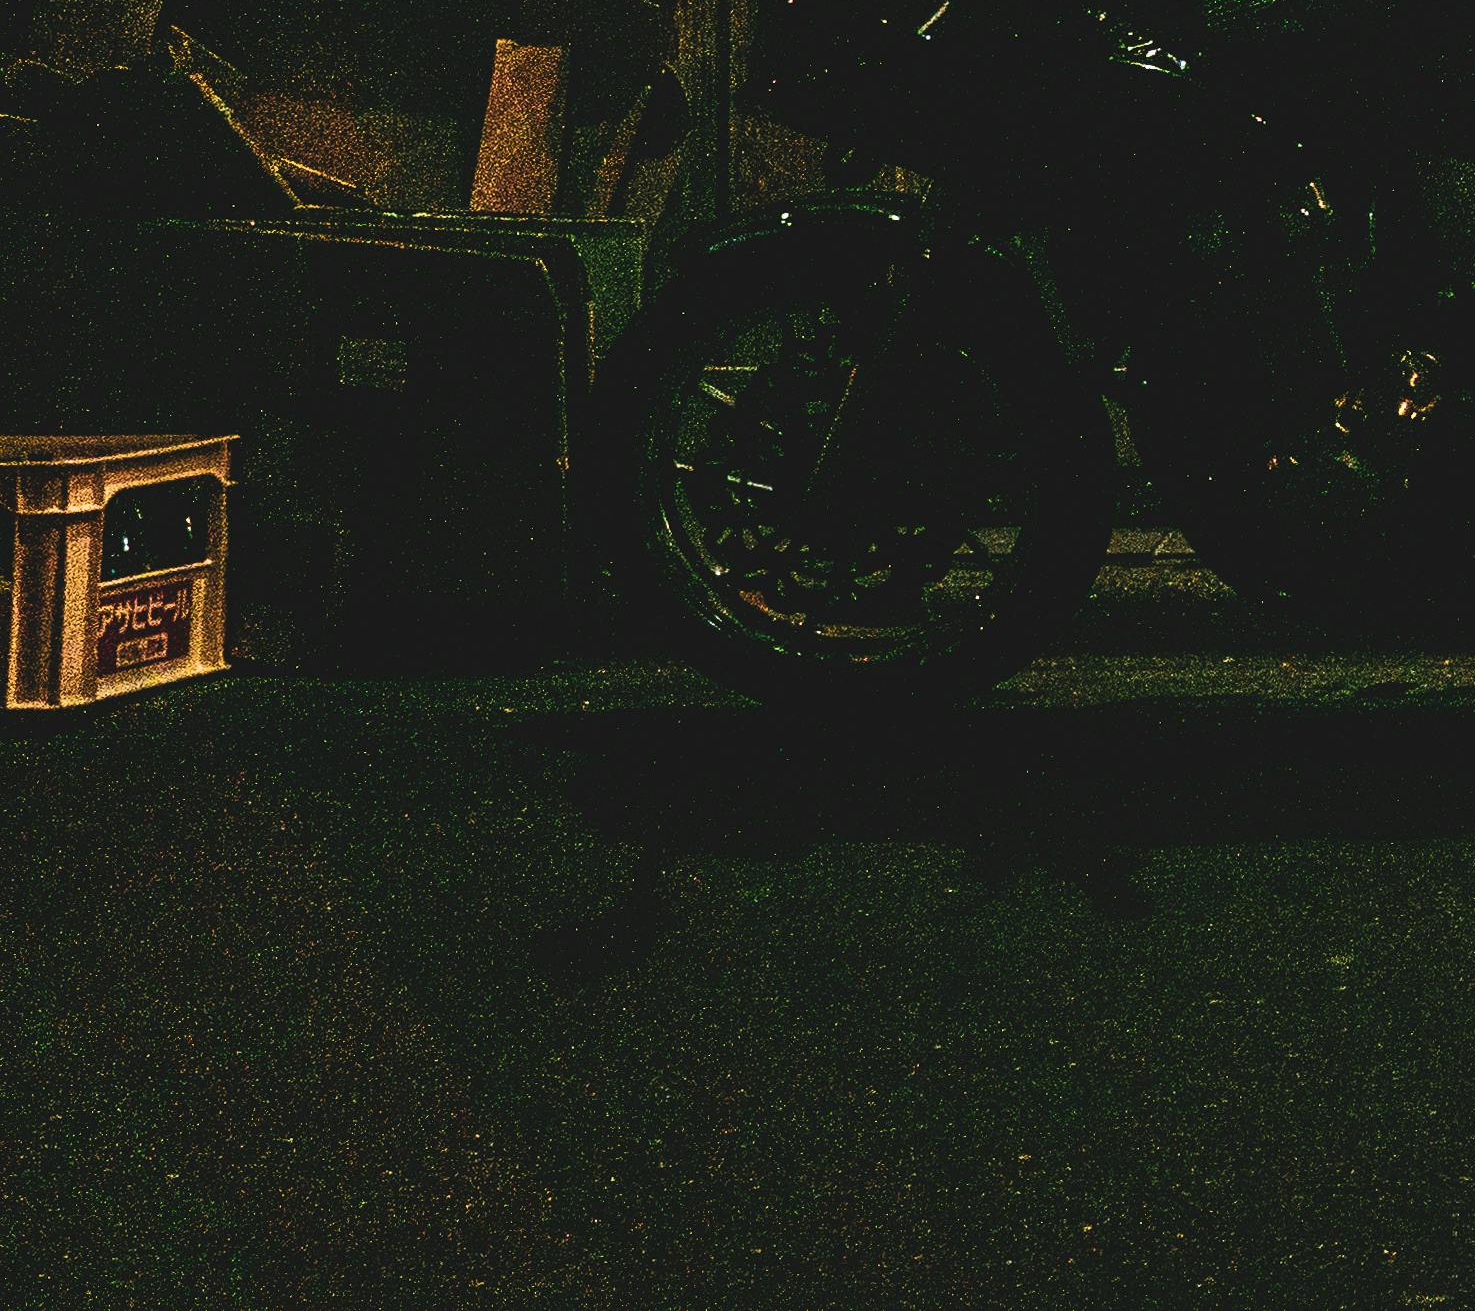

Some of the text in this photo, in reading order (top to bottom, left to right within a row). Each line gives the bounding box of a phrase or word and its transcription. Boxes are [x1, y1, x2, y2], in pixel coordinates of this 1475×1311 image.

[97, 588, 190, 637] アサヒビール
